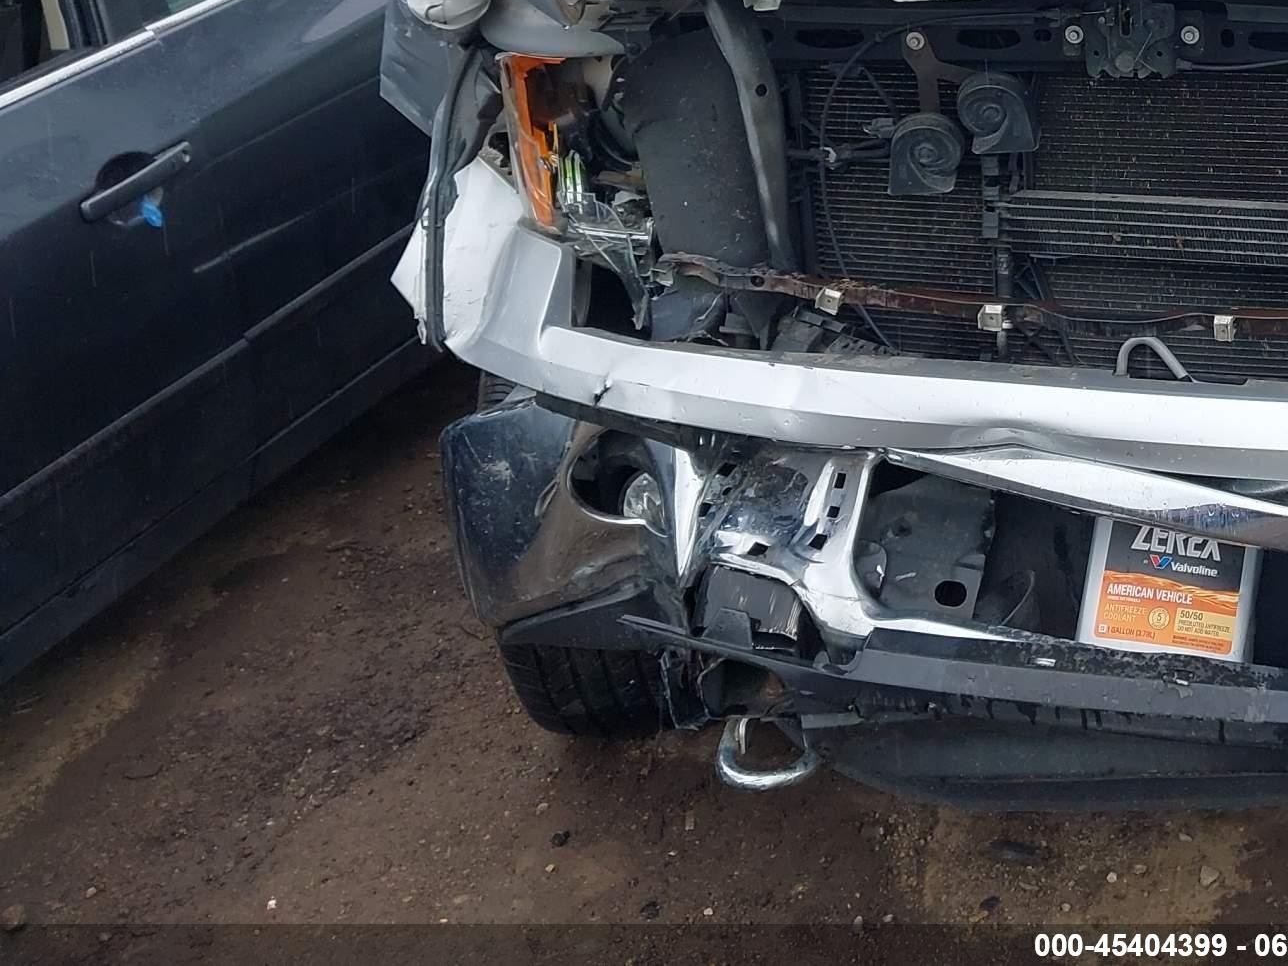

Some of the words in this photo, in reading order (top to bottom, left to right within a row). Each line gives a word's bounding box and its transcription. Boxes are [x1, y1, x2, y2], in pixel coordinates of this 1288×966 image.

[1171, 561, 1218, 577] Valvoline
[1107, 583, 1154, 600] AMERICAN
[1156, 588, 1193, 605] VEHICLE
[1104, 602, 1147, 615] ANTIFREEZE
[1103, 611, 1137, 622] COOLANT
[1180, 609, 1204, 621] 50/50
[1110, 626, 1135, 636] GALLON
